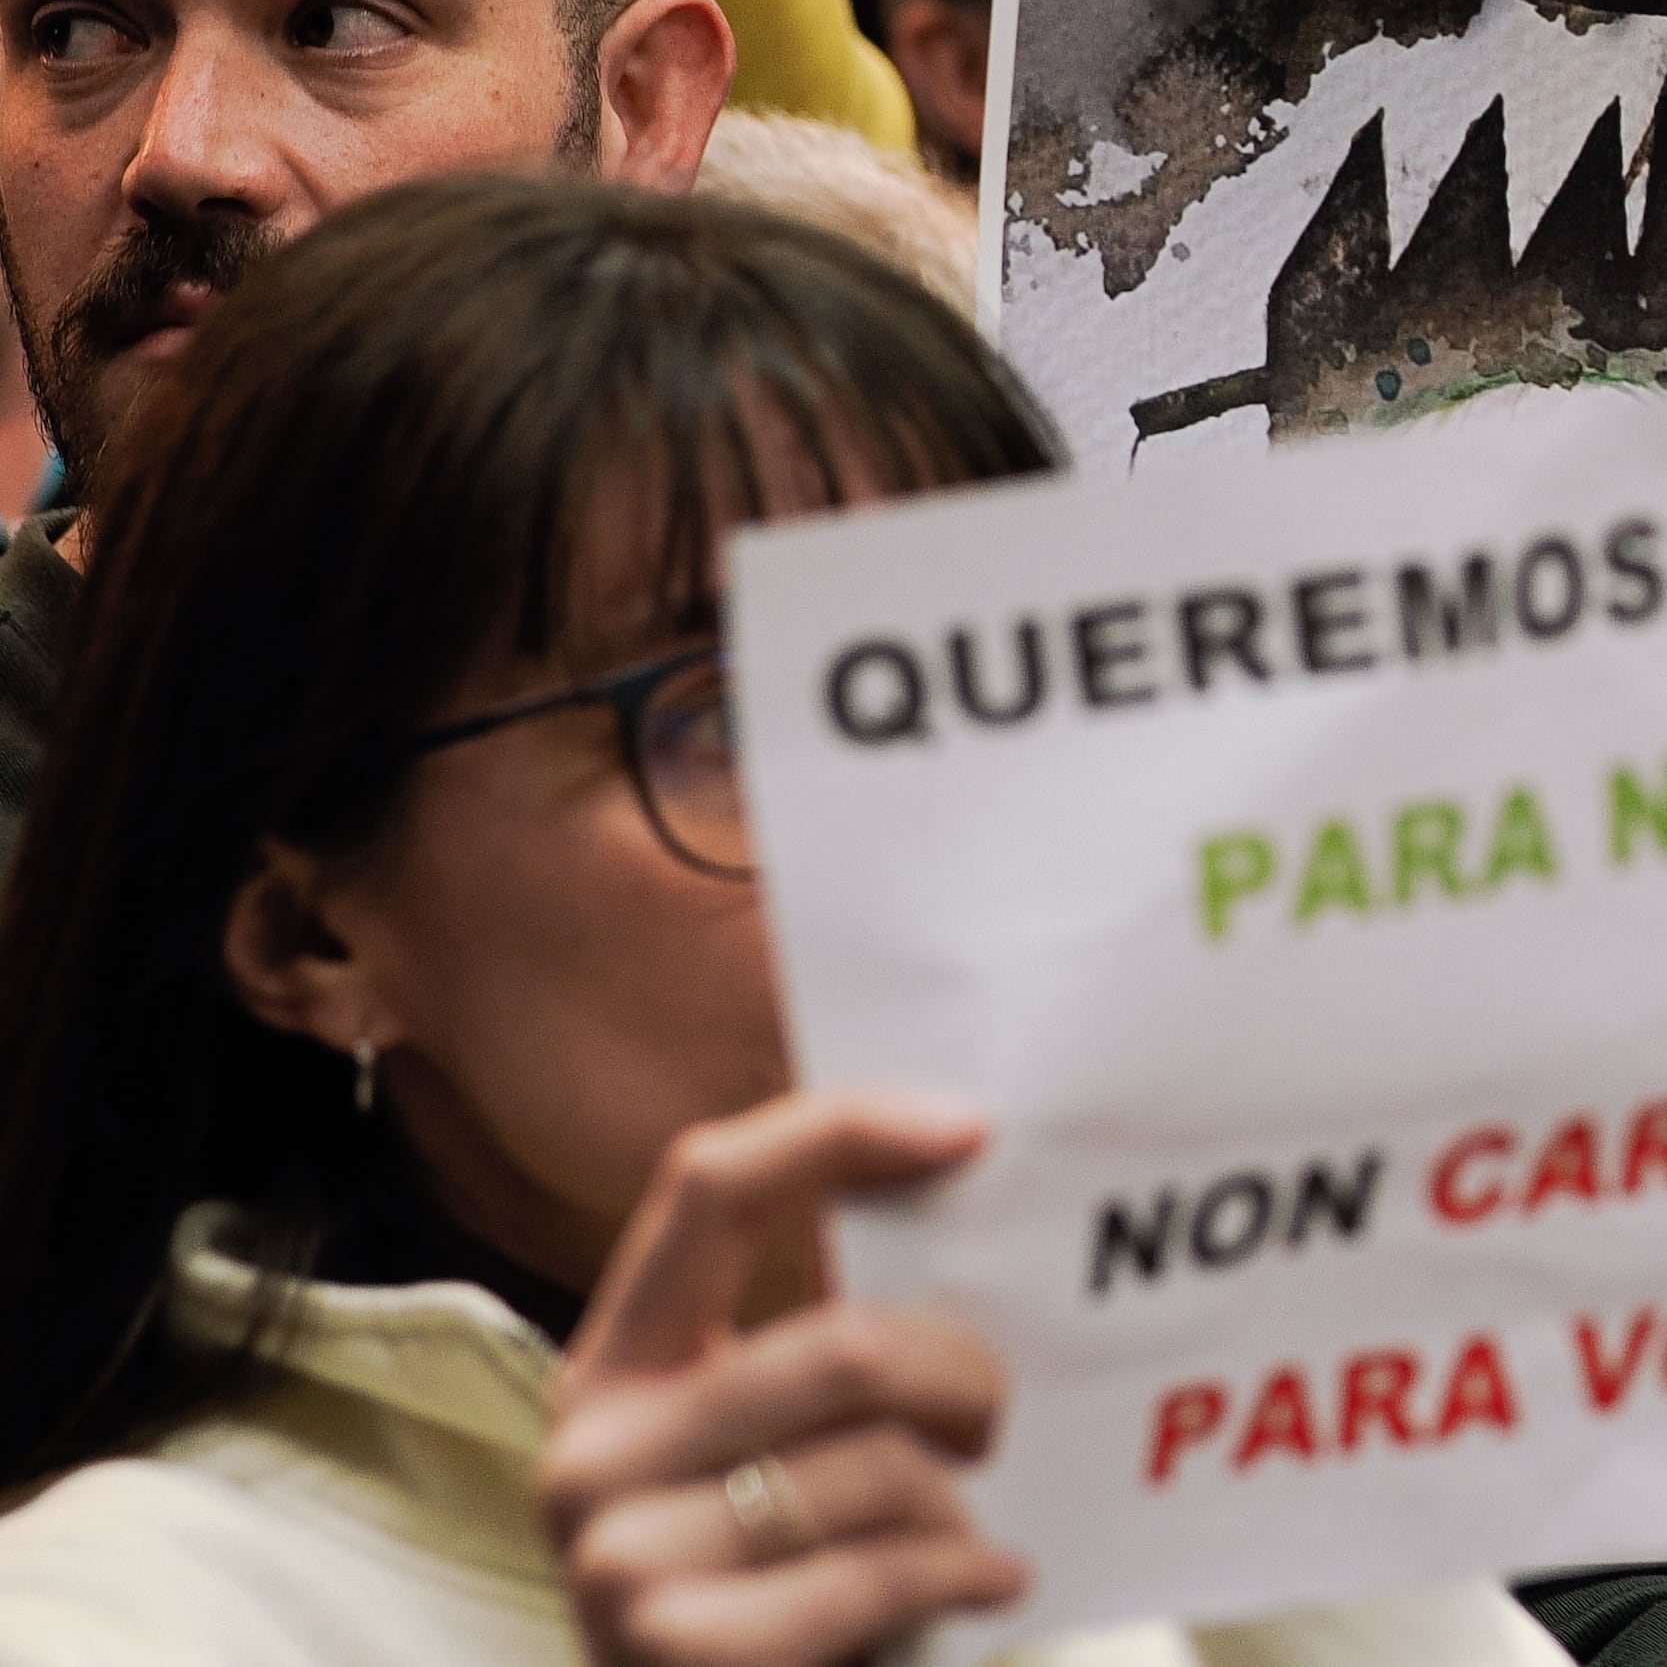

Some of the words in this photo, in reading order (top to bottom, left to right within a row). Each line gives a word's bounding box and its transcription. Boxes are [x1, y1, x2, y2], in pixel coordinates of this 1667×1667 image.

[822, 518, 1667, 745] QUEREMOS
[1195, 784, 1560, 940] PARA
[1085, 1146, 1389, 1300] NON
[1147, 1332, 1520, 1485] PARA
